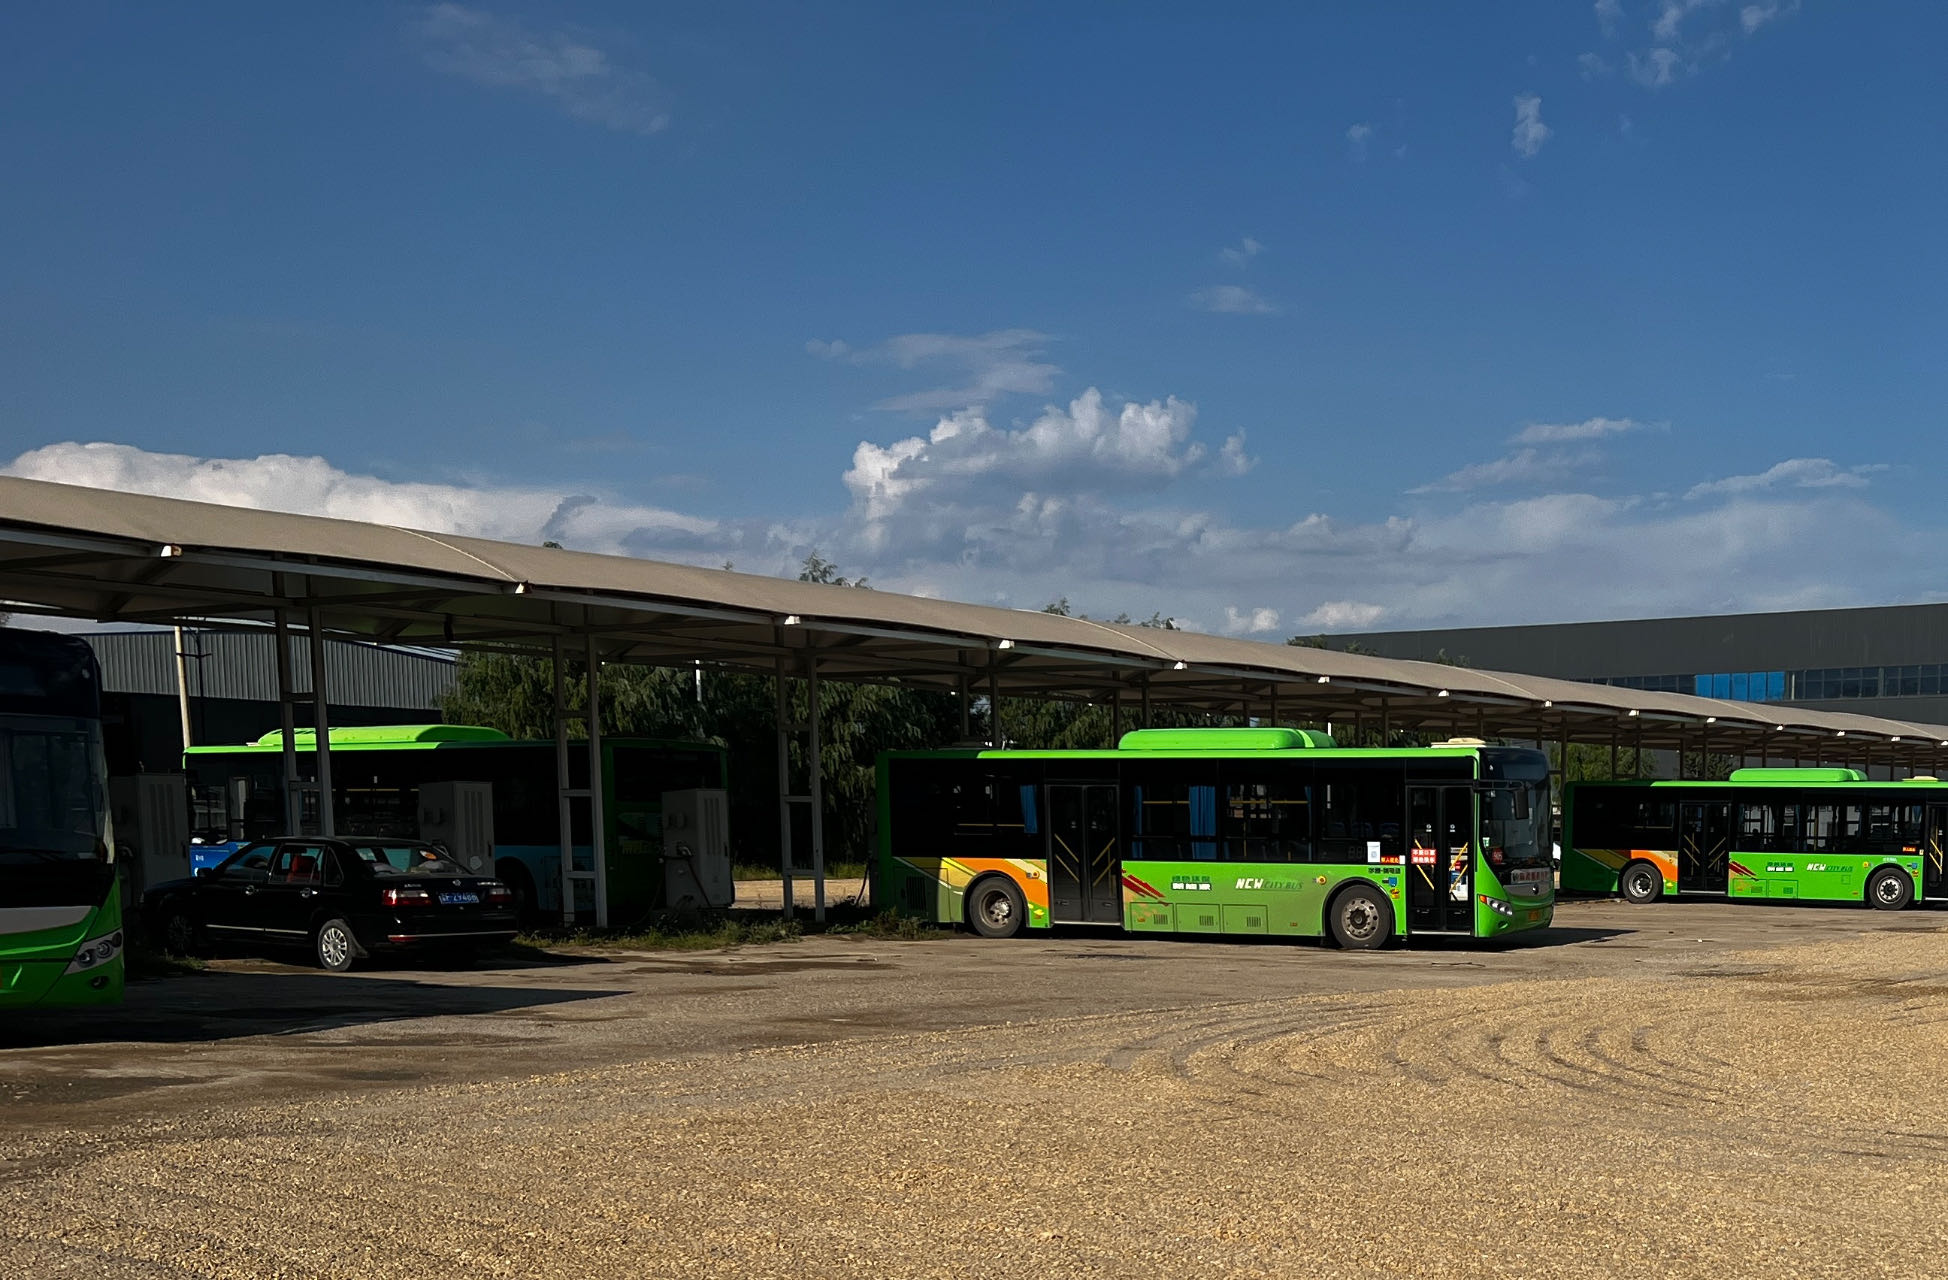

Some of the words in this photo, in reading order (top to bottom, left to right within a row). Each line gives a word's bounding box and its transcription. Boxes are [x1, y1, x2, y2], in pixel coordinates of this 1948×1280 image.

[1807, 863, 1826, 871] NEW
[1235, 878, 1264, 890] NEW
[1264, 880, 1284, 889] CITY
[1286, 880, 1303, 889] BUS
